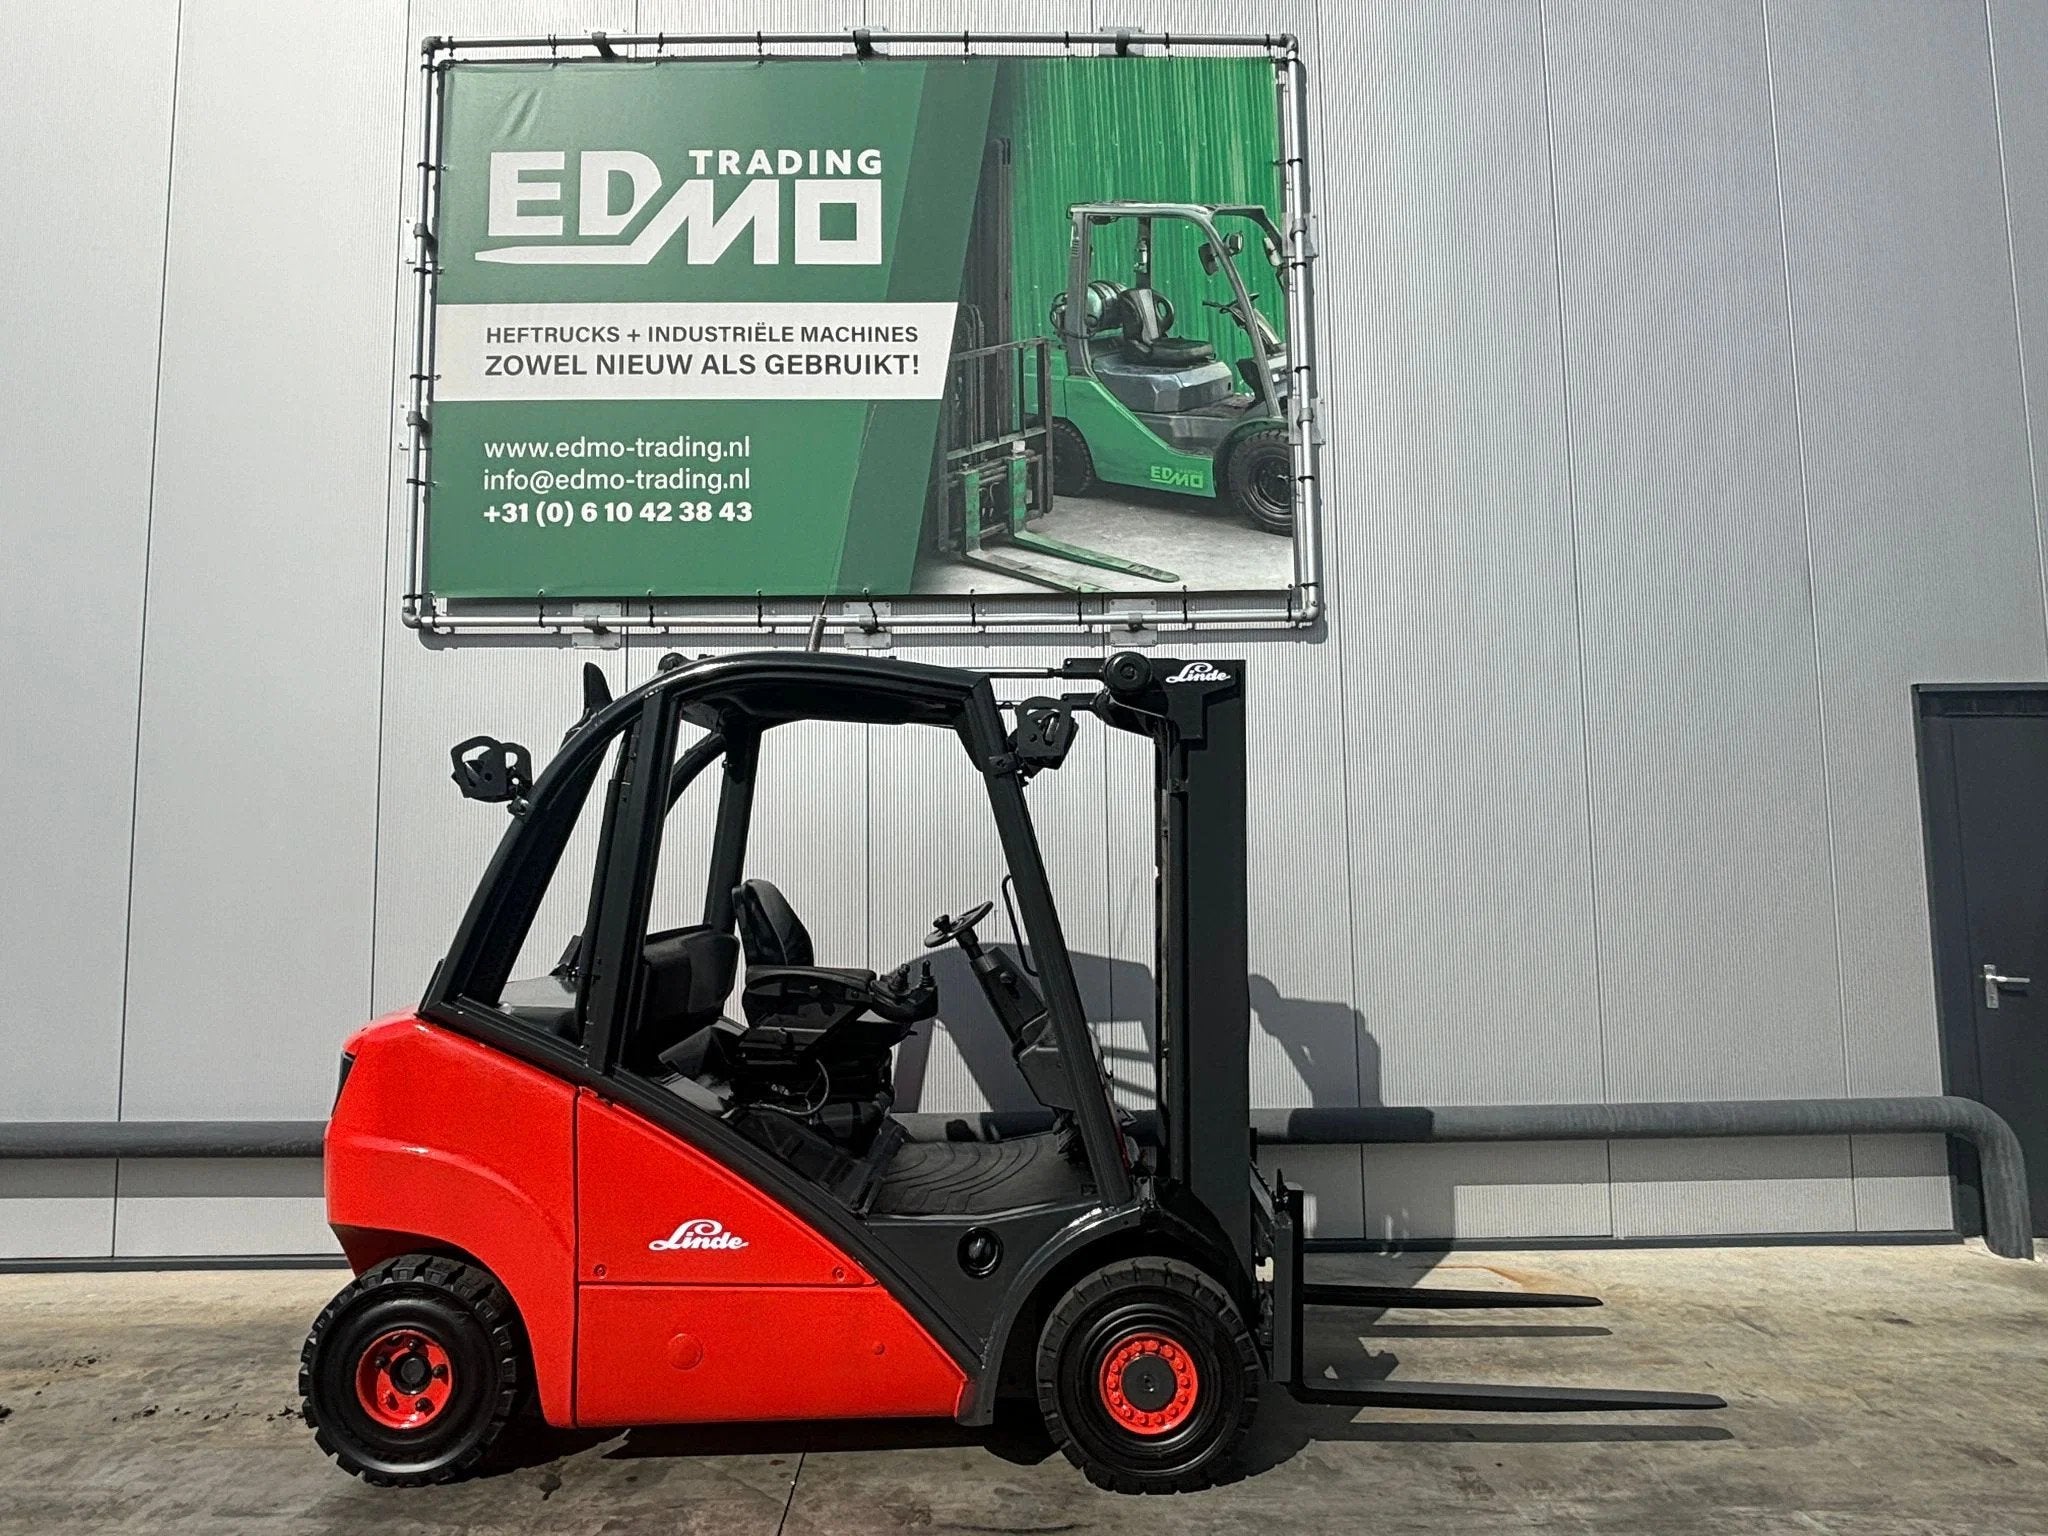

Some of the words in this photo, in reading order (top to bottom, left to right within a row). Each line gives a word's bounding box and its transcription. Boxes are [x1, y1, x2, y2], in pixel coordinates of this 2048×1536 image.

[688, 148, 882, 176] TRADING
[474, 150, 882, 265] EDMO
[486, 326, 620, 344] HEFTRUCKS
[627, 329, 641, 343] +
[648, 321, 794, 344] INDUSTRIËLE
[801, 326, 919, 343] MACHINES
[485, 354, 588, 376] ZOWEL
[596, 354, 694, 376] NIEUW
[700, 354, 756, 376] ALS
[765, 353, 920, 376] GEBRUIKT!
[484, 436, 750, 463] www.edmo-trading.nl
[483, 468, 750, 495] info@edmo-trading.nl
[1150, 465, 1204, 488] EDMO
[483, 502, 529, 523] +31
[535, 501, 574, 528] (0)
[580, 501, 598, 523] 6
[604, 501, 633, 522] 10
[639, 501, 673, 522] 42
[678, 501, 713, 522] 38
[718, 501, 753, 522] 43
[1166, 662, 1231, 683] Linde
[648, 1219, 749, 1250] Linde
